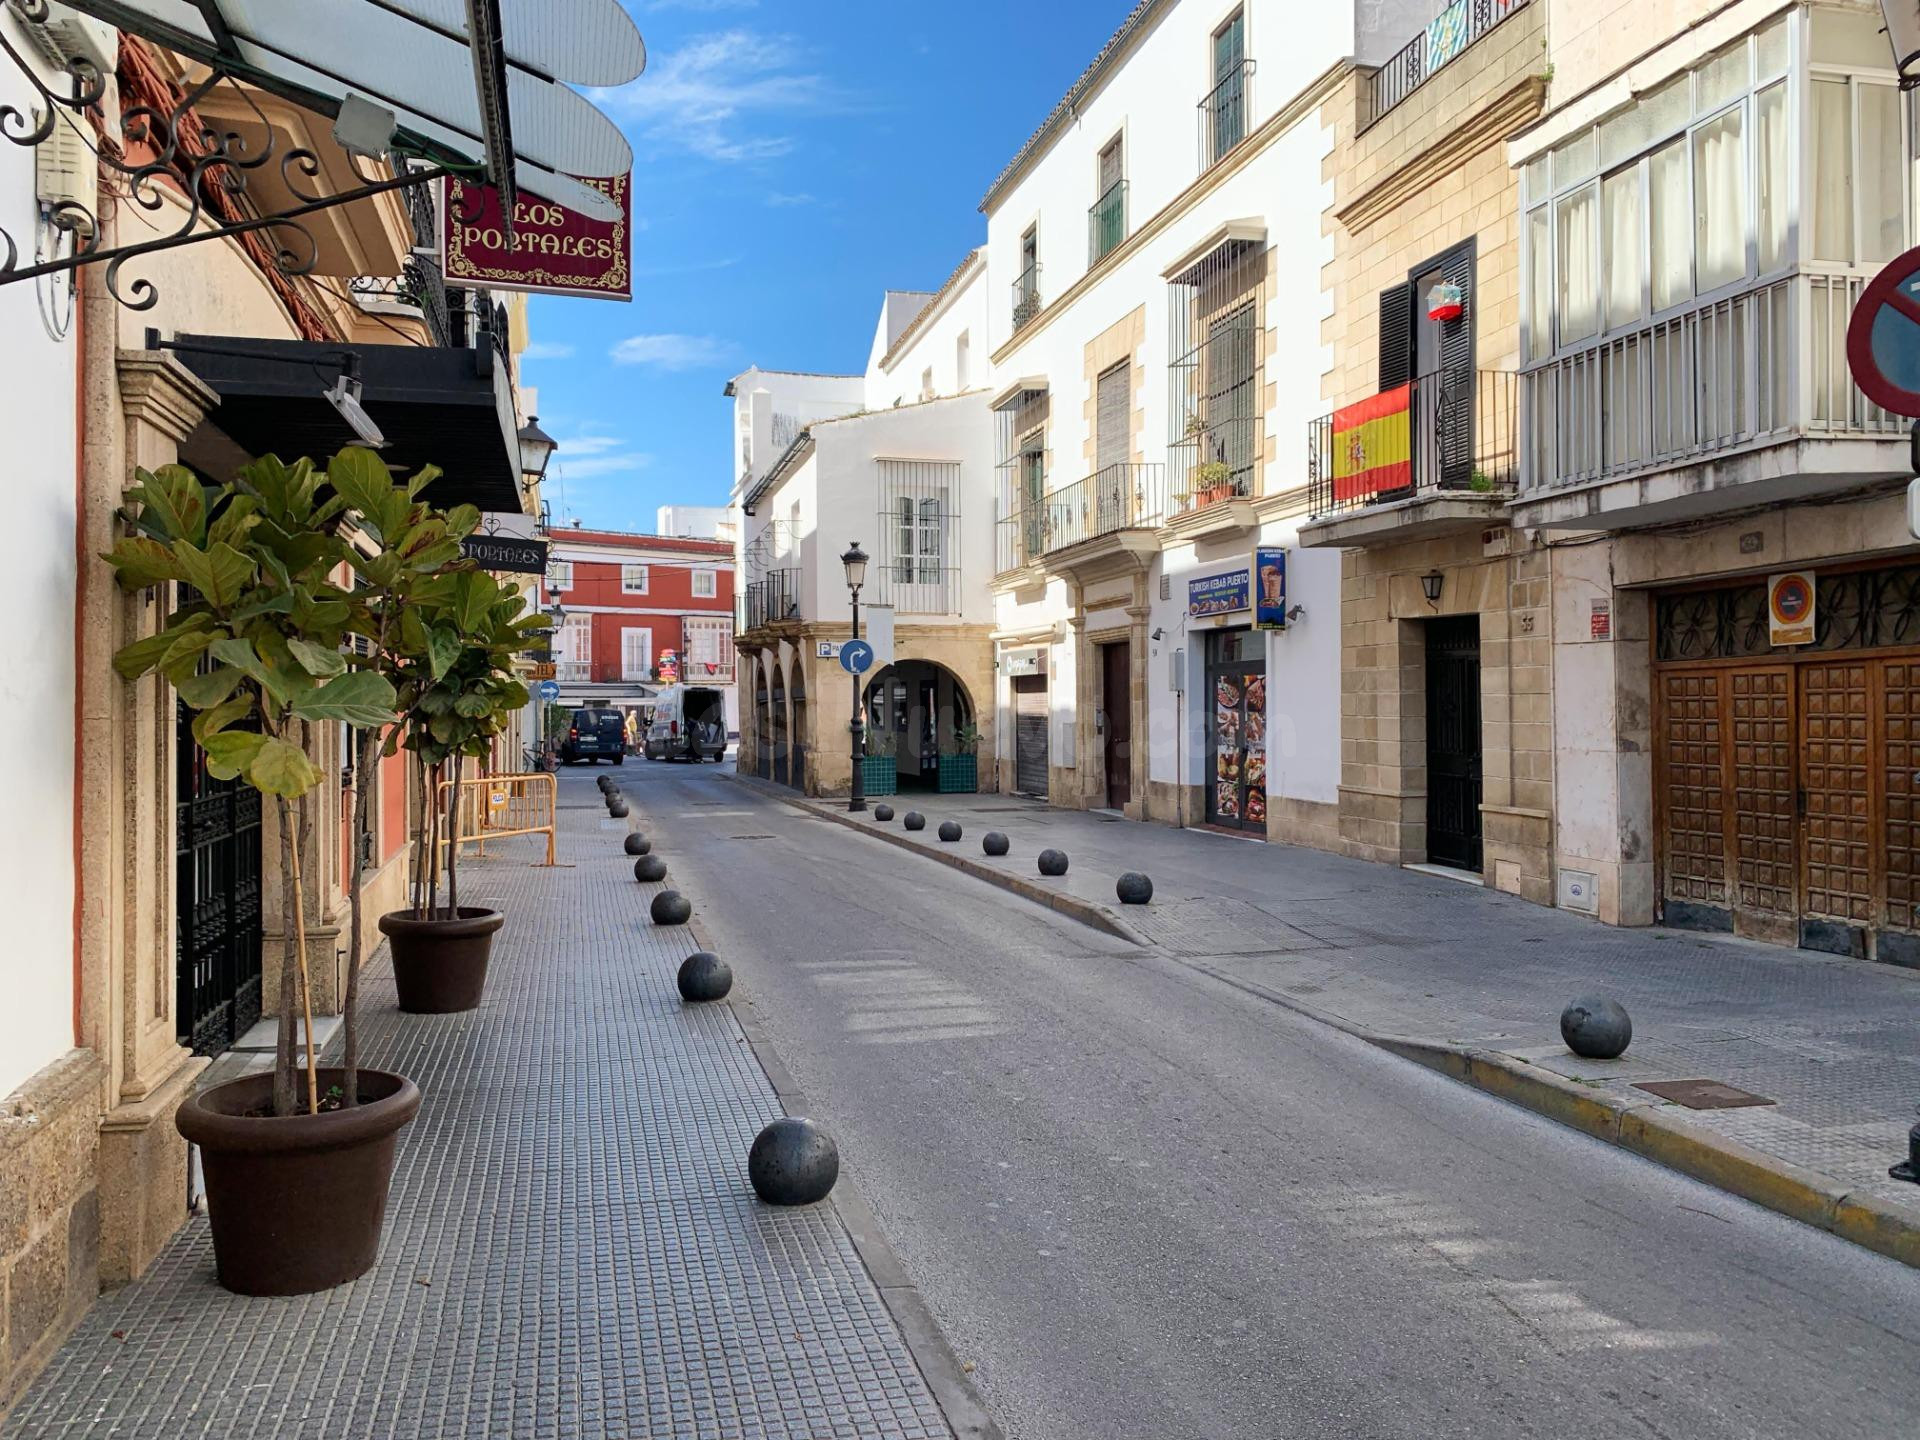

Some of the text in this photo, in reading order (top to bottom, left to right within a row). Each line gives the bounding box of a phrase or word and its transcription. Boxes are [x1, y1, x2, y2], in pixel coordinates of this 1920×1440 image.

[514, 202, 565, 227] LOS
[468, 543, 540, 564] PORTALES
[1190, 573, 1248, 593] TURKISH KEBAB PUERTO
